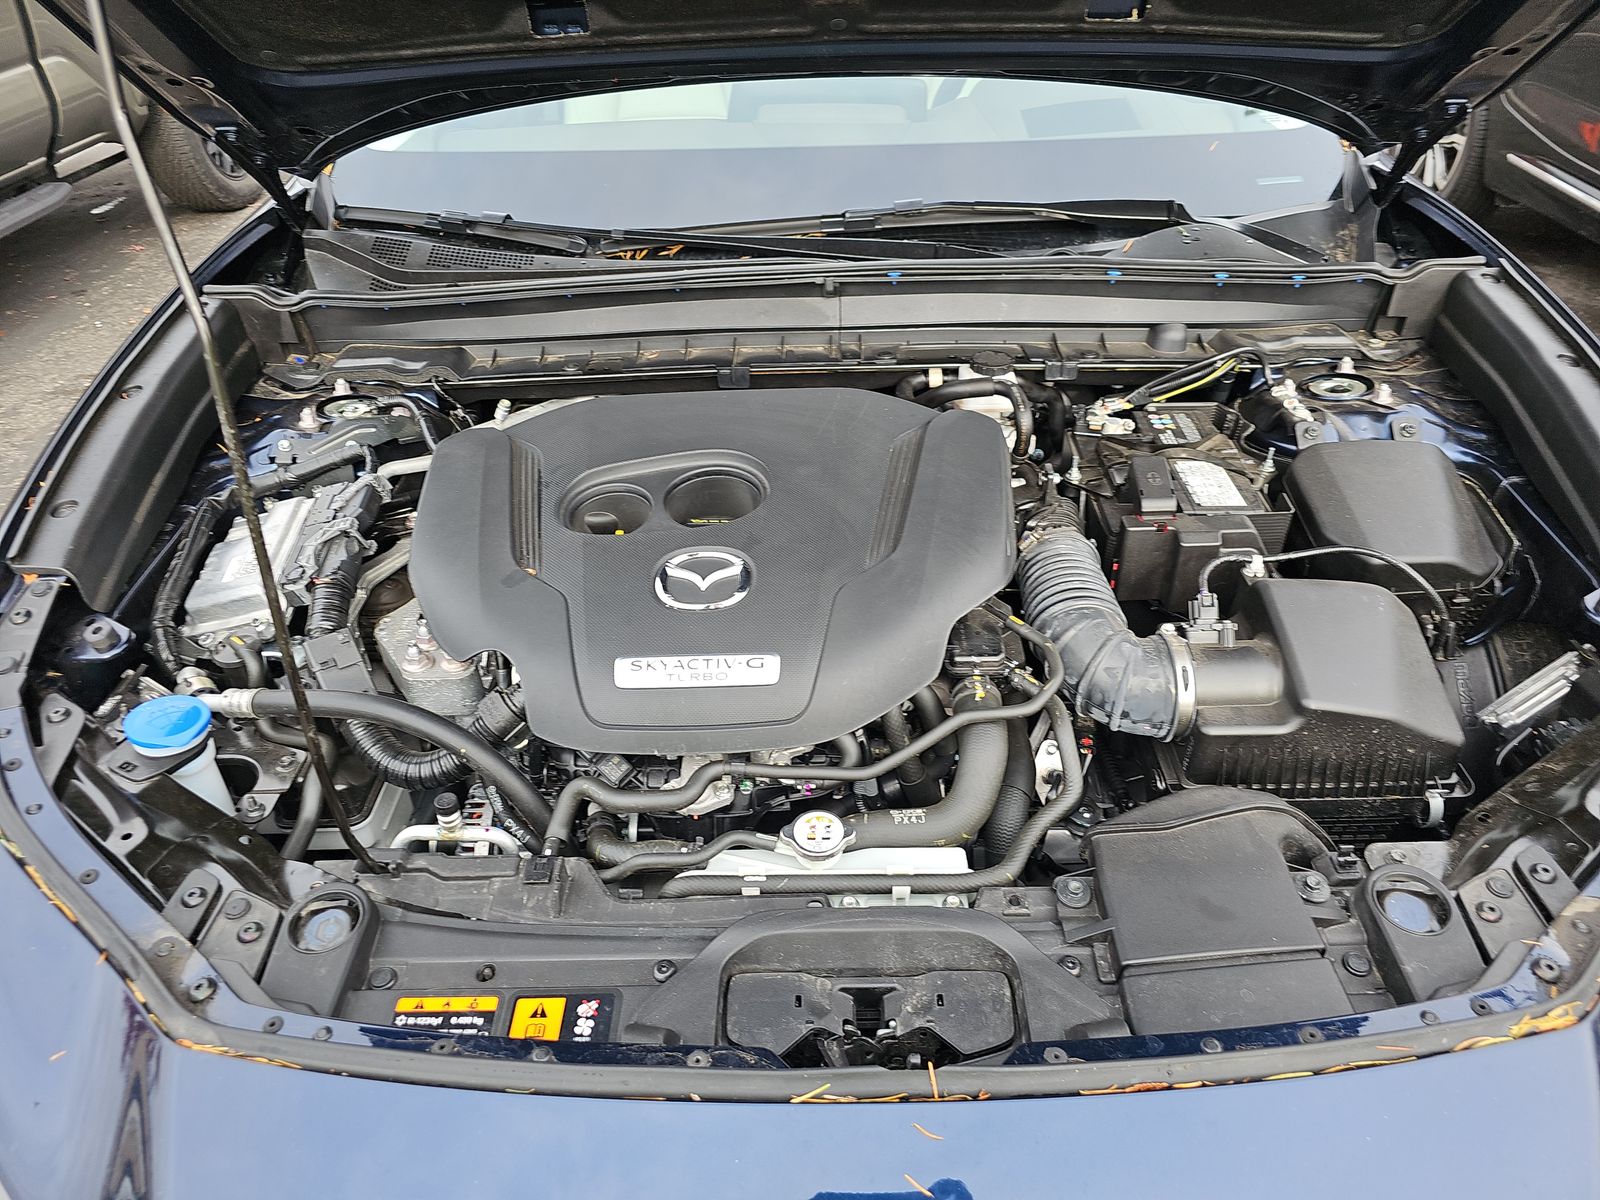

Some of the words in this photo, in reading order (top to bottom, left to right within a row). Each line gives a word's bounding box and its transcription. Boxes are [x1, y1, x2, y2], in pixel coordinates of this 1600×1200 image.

[630, 657, 765, 672] SKYACTIV-G
[666, 672, 729, 682] TURBO
[894, 815, 926, 825] PX4J
